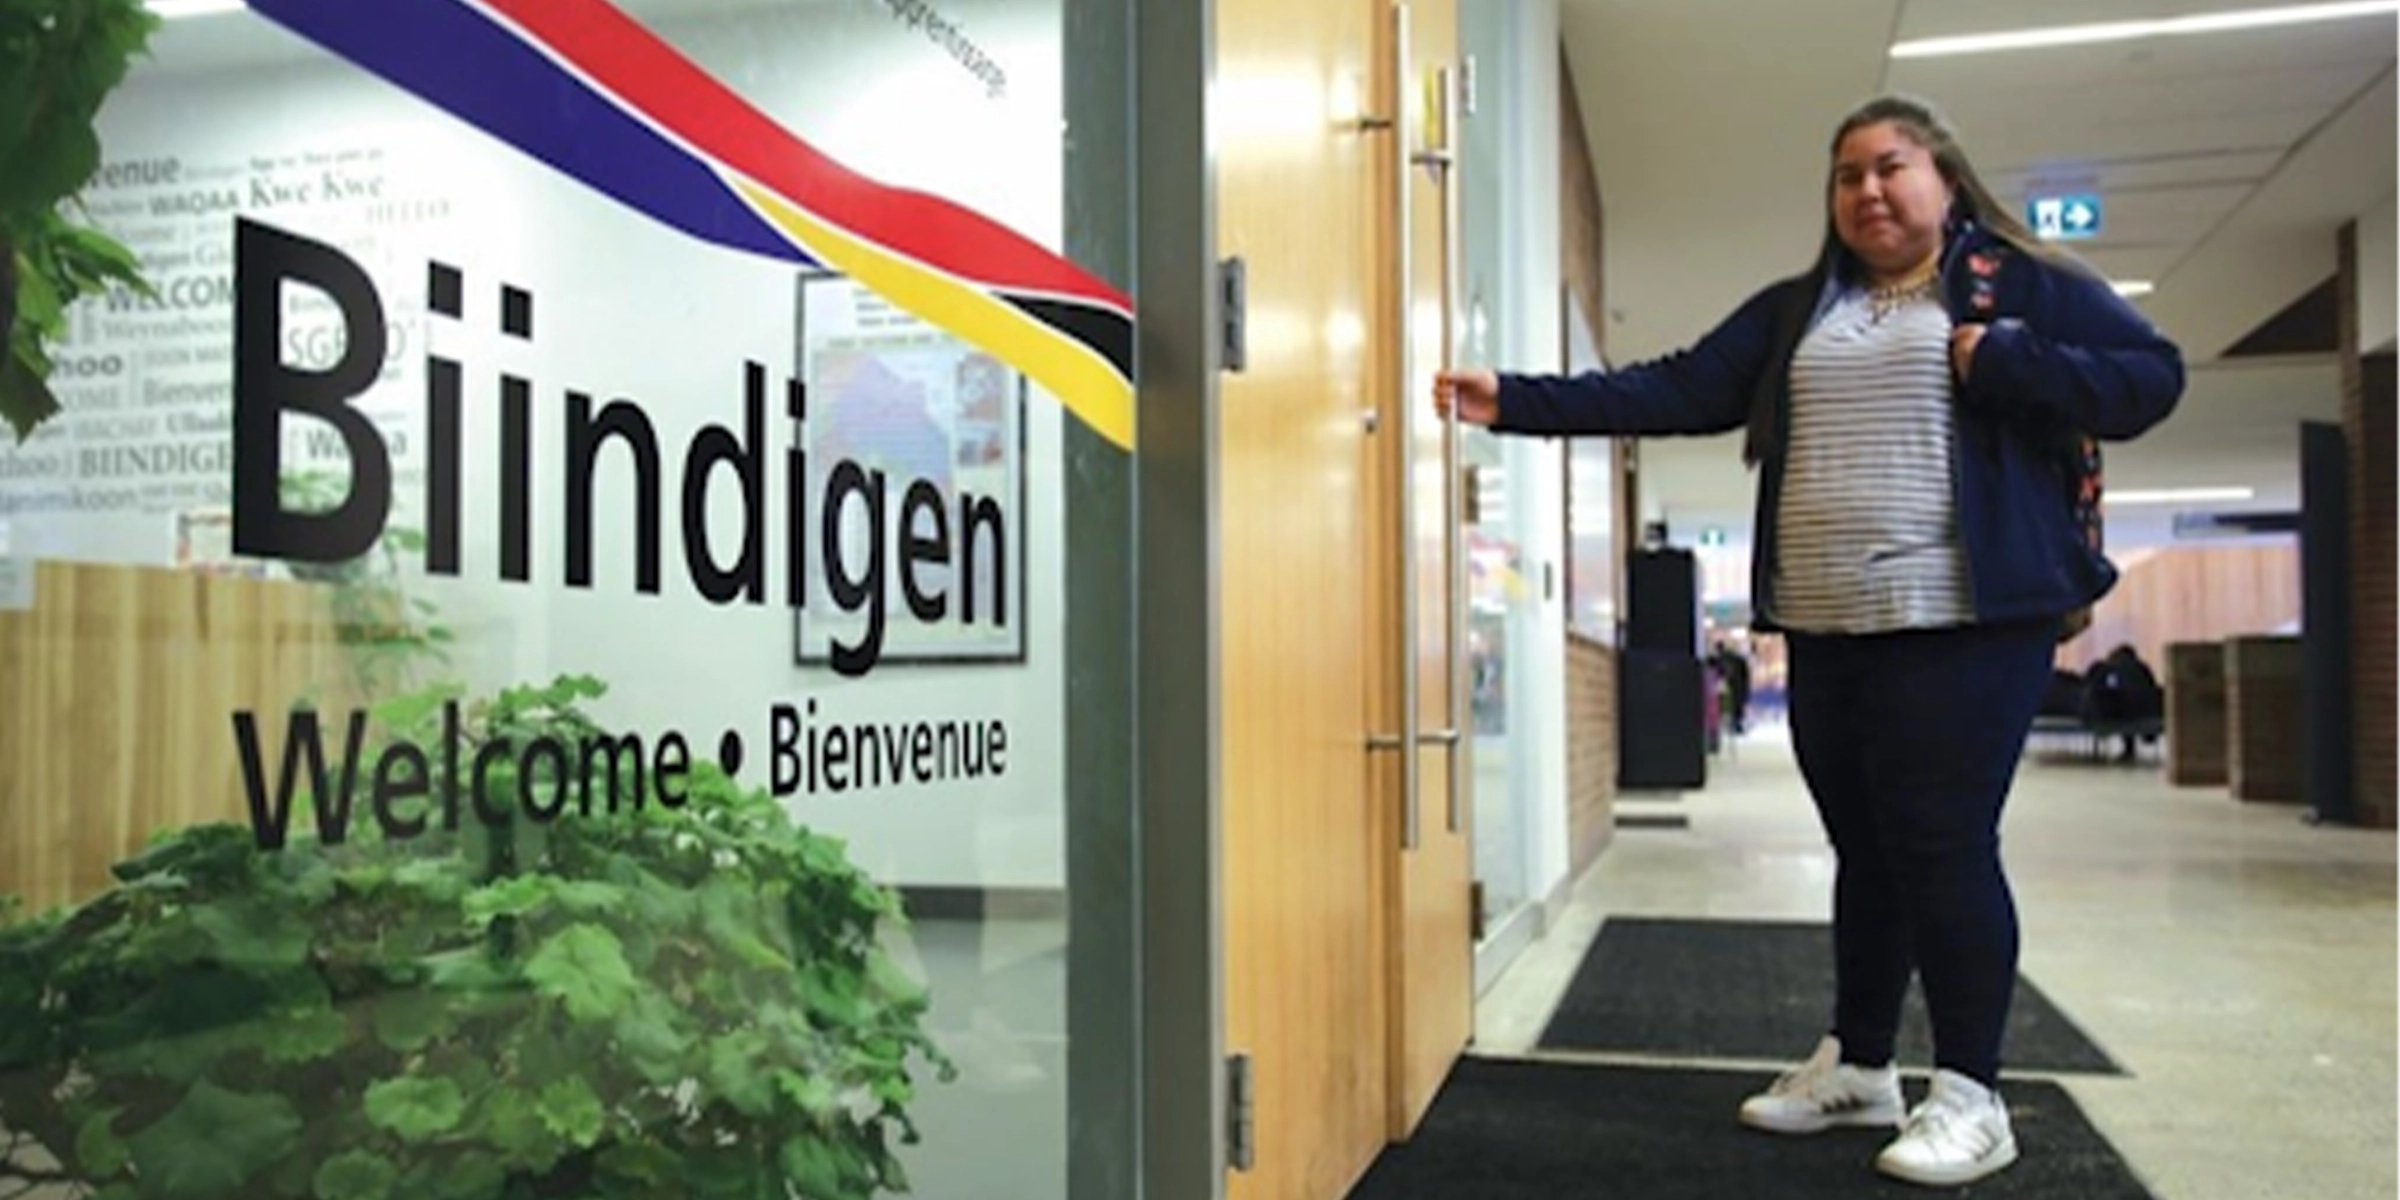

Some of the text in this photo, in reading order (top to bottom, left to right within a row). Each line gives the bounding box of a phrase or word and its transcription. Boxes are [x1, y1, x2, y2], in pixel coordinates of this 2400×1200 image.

[249, 177, 312, 209] Kwe
[232, 216, 1006, 675] Biindigen
[232, 699, 1007, 852] Welcome Bienvenue
